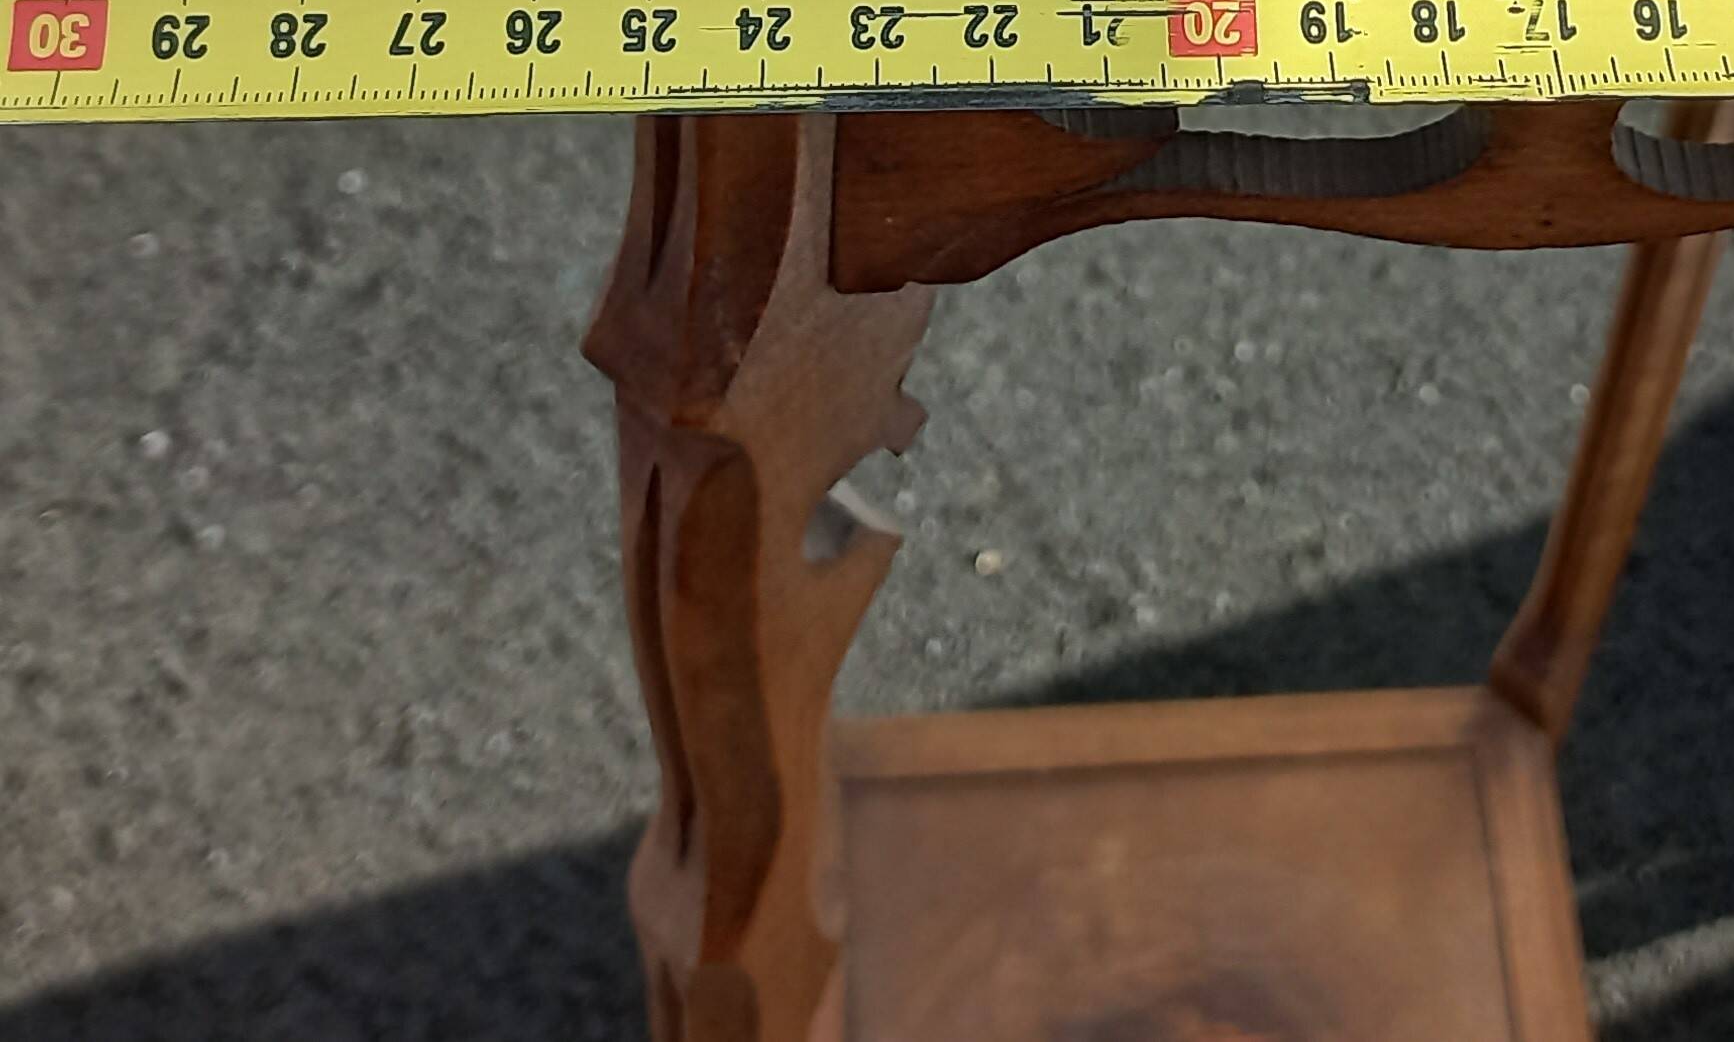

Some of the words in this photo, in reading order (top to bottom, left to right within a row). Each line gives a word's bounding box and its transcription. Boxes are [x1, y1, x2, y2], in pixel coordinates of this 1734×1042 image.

[28, 13, 90, 57] 30
[151, 14, 211, 59] 29
[270, 13, 328, 57] 28
[389, 11, 447, 56] 27
[506, 9, 563, 55] 26
[621, 8, 677, 52] 25
[736, 7, 792, 51] 24
[850, 6, 904, 49] 23
[963, 4, 1018, 49] 22
[1184, 1, 1241, 45] 20
[1300, 0, 1353, 44] 19
[1411, 0, 1466, 43] 18
